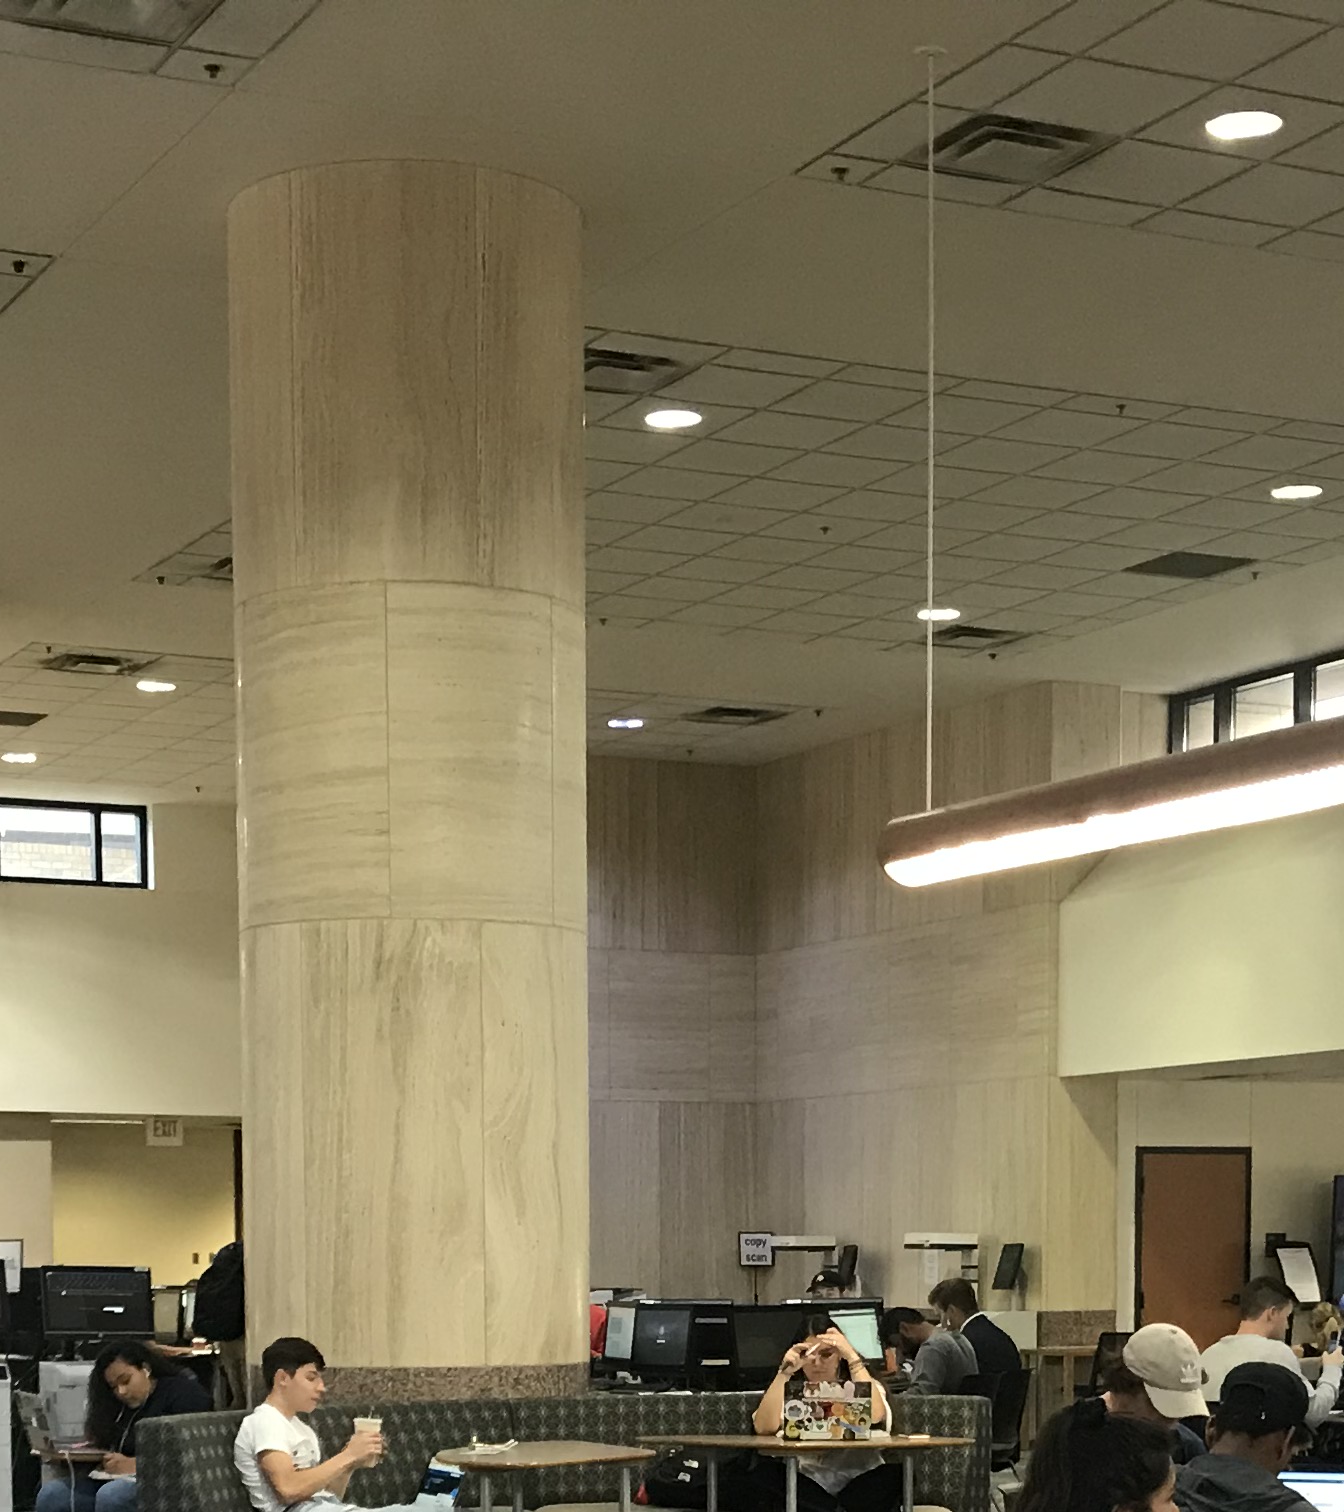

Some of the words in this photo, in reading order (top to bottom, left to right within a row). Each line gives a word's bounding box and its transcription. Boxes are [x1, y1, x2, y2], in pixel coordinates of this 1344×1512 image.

[153, 1119, 177, 1137] EXIT
[745, 1238, 767, 1248] copy
[746, 1253, 767, 1262] scan
